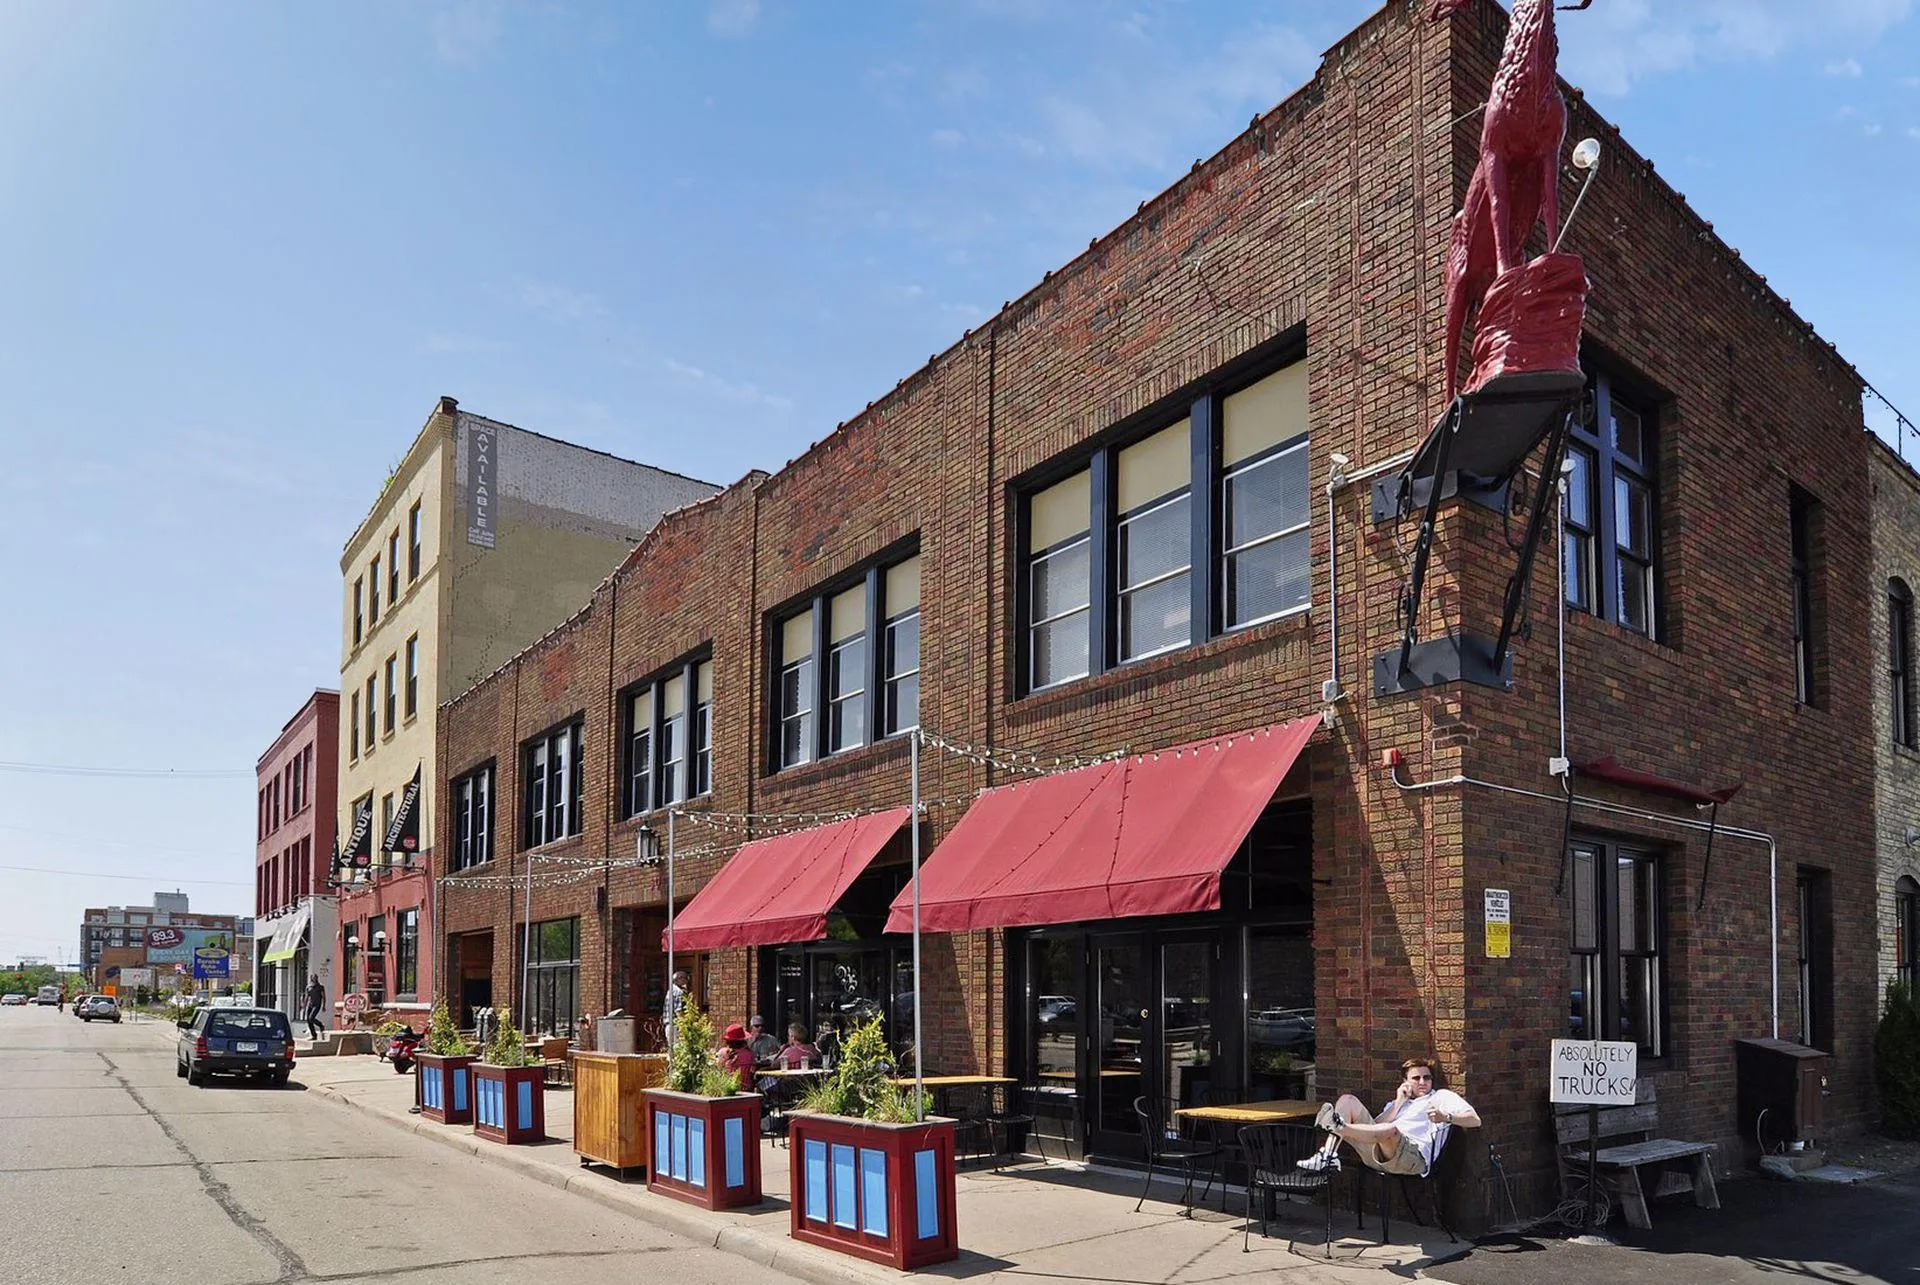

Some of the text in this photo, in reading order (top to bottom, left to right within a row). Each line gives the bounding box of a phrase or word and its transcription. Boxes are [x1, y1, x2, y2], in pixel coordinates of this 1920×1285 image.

[477, 434, 489, 527] AVAILABLE
[384, 782, 420, 851] ARCHITECTURAL
[340, 810, 372, 867] ANTIQUE
[152, 929, 175, 942] 89.3
[1559, 1046, 1633, 1062] ABSOLUTELY
[1583, 1061, 1607, 1077] NO
